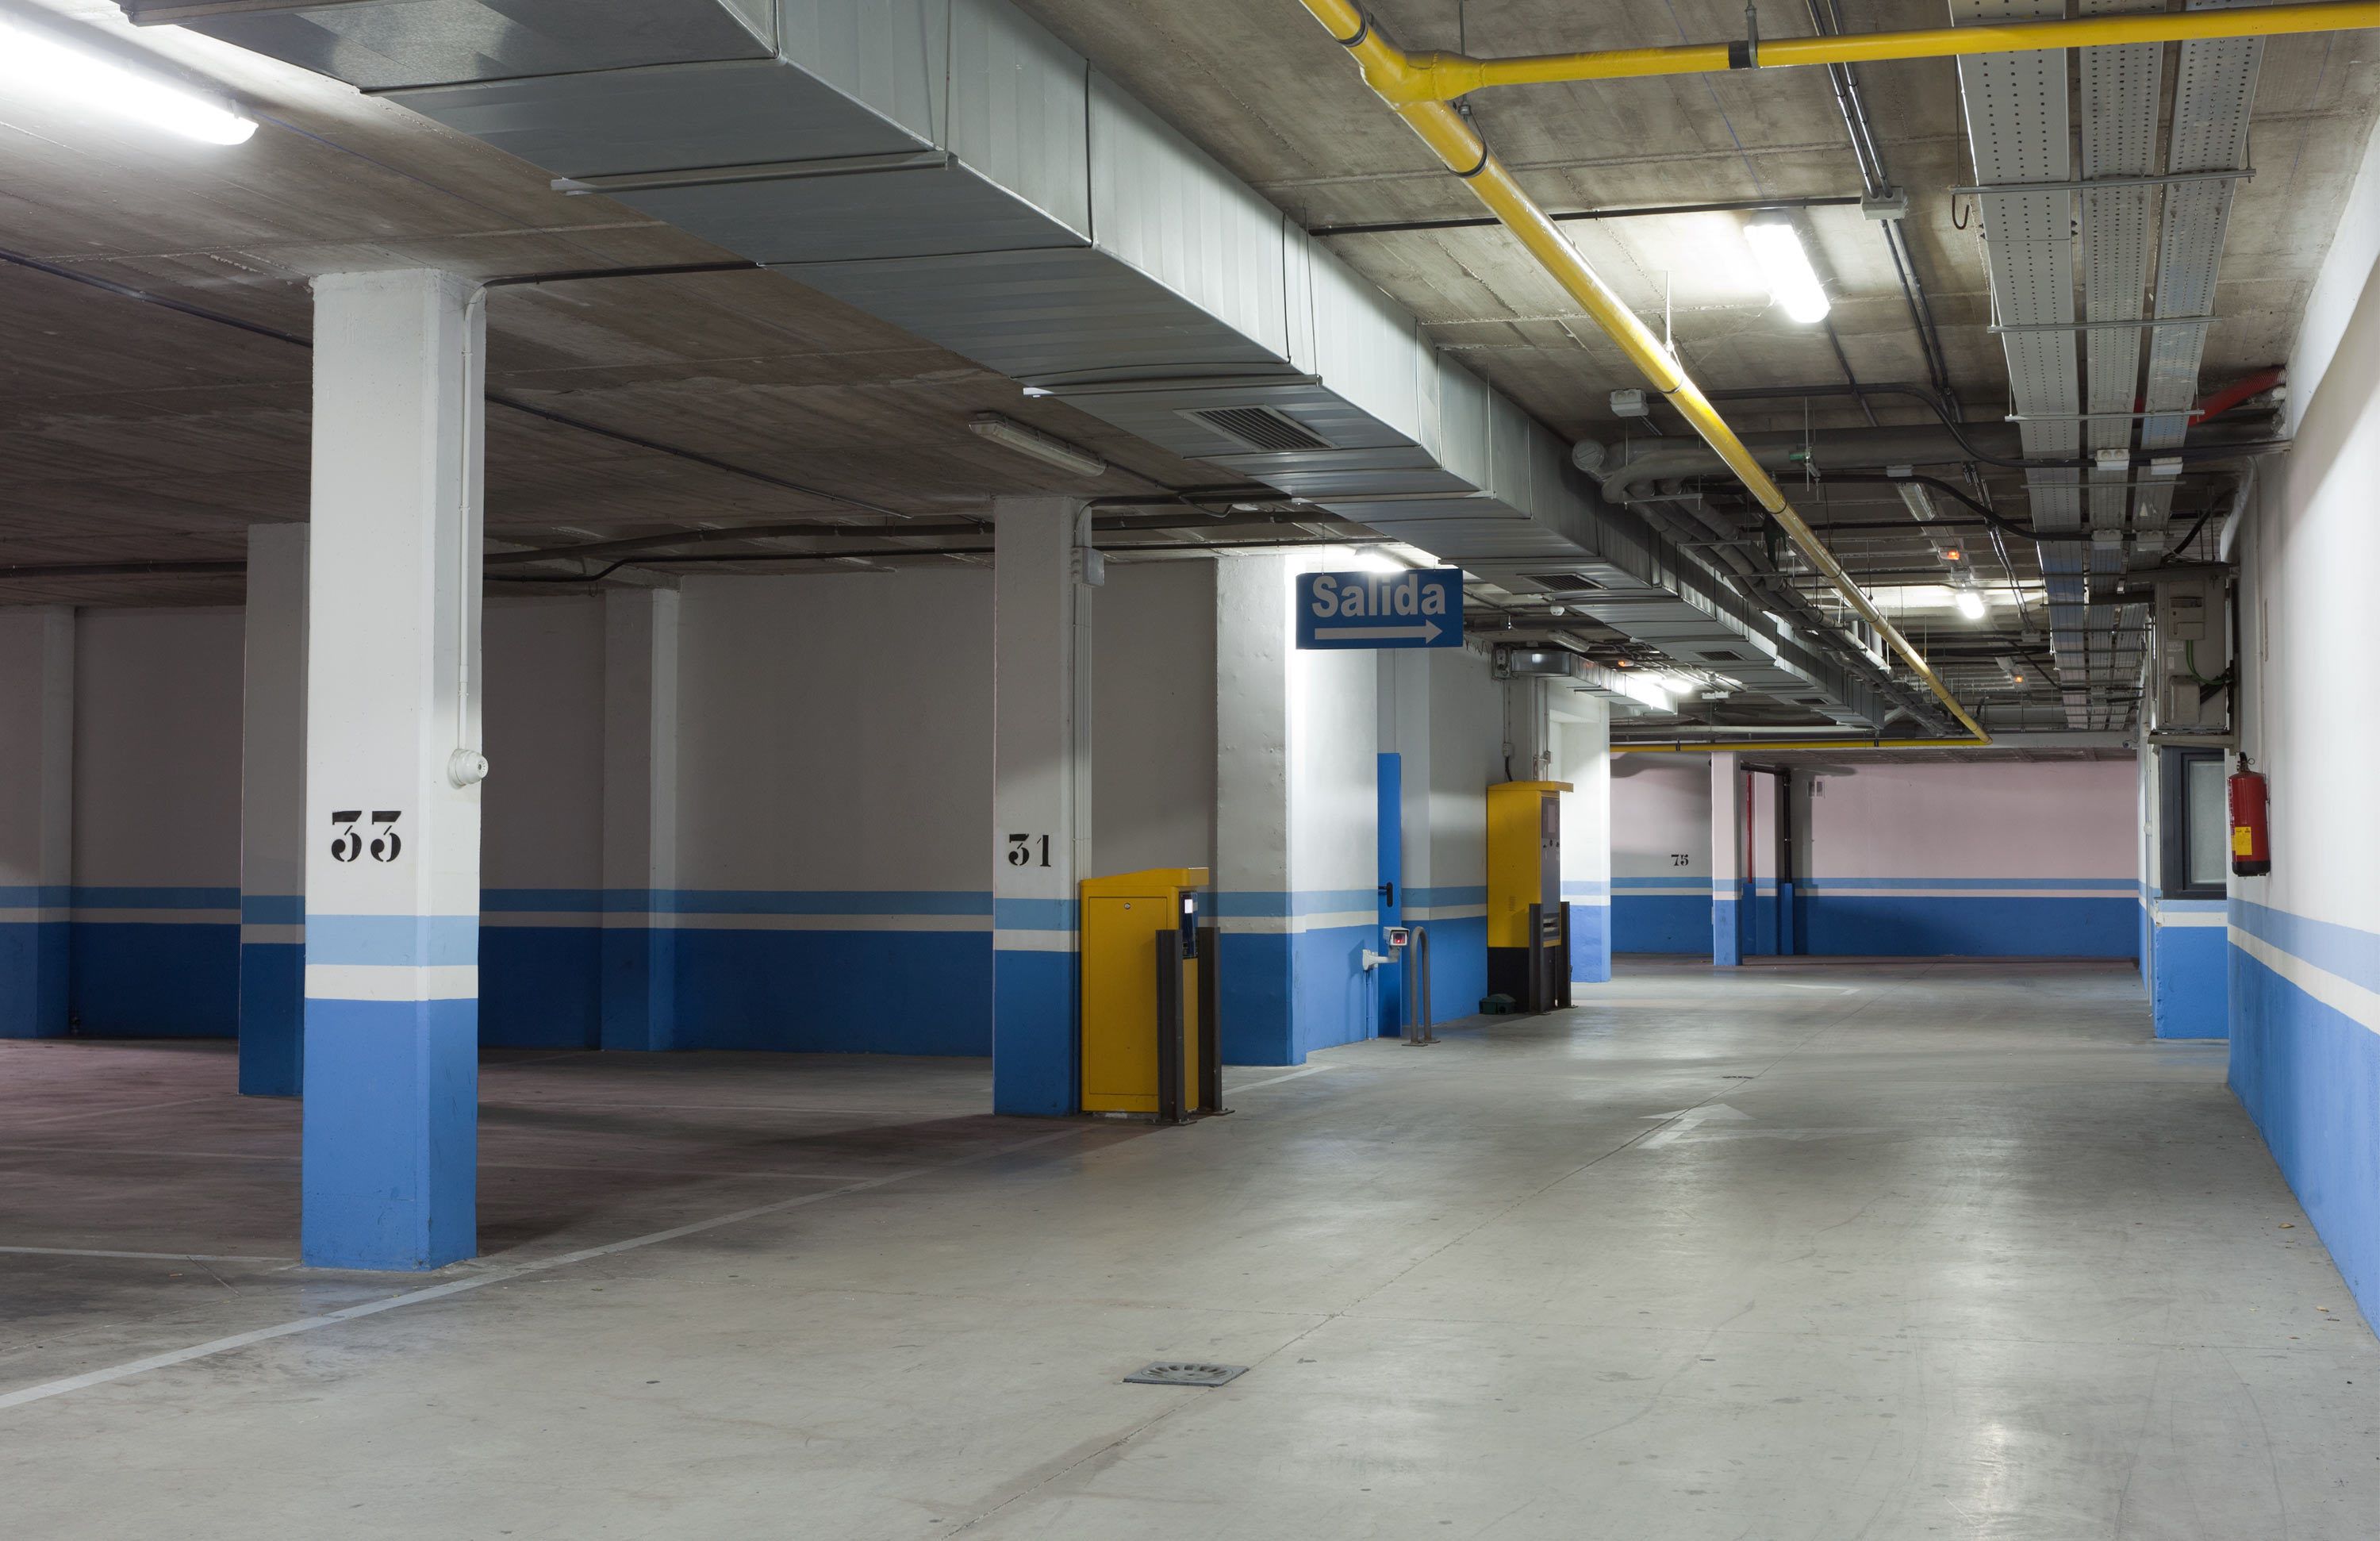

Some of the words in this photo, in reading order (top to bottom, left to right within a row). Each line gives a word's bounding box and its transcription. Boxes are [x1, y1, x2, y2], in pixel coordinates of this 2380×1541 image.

[1311, 574, 1446, 617] Salida
[331, 810, 401, 863] 33
[1008, 834, 1051, 867] 31
[1671, 854, 1689, 867] 75
